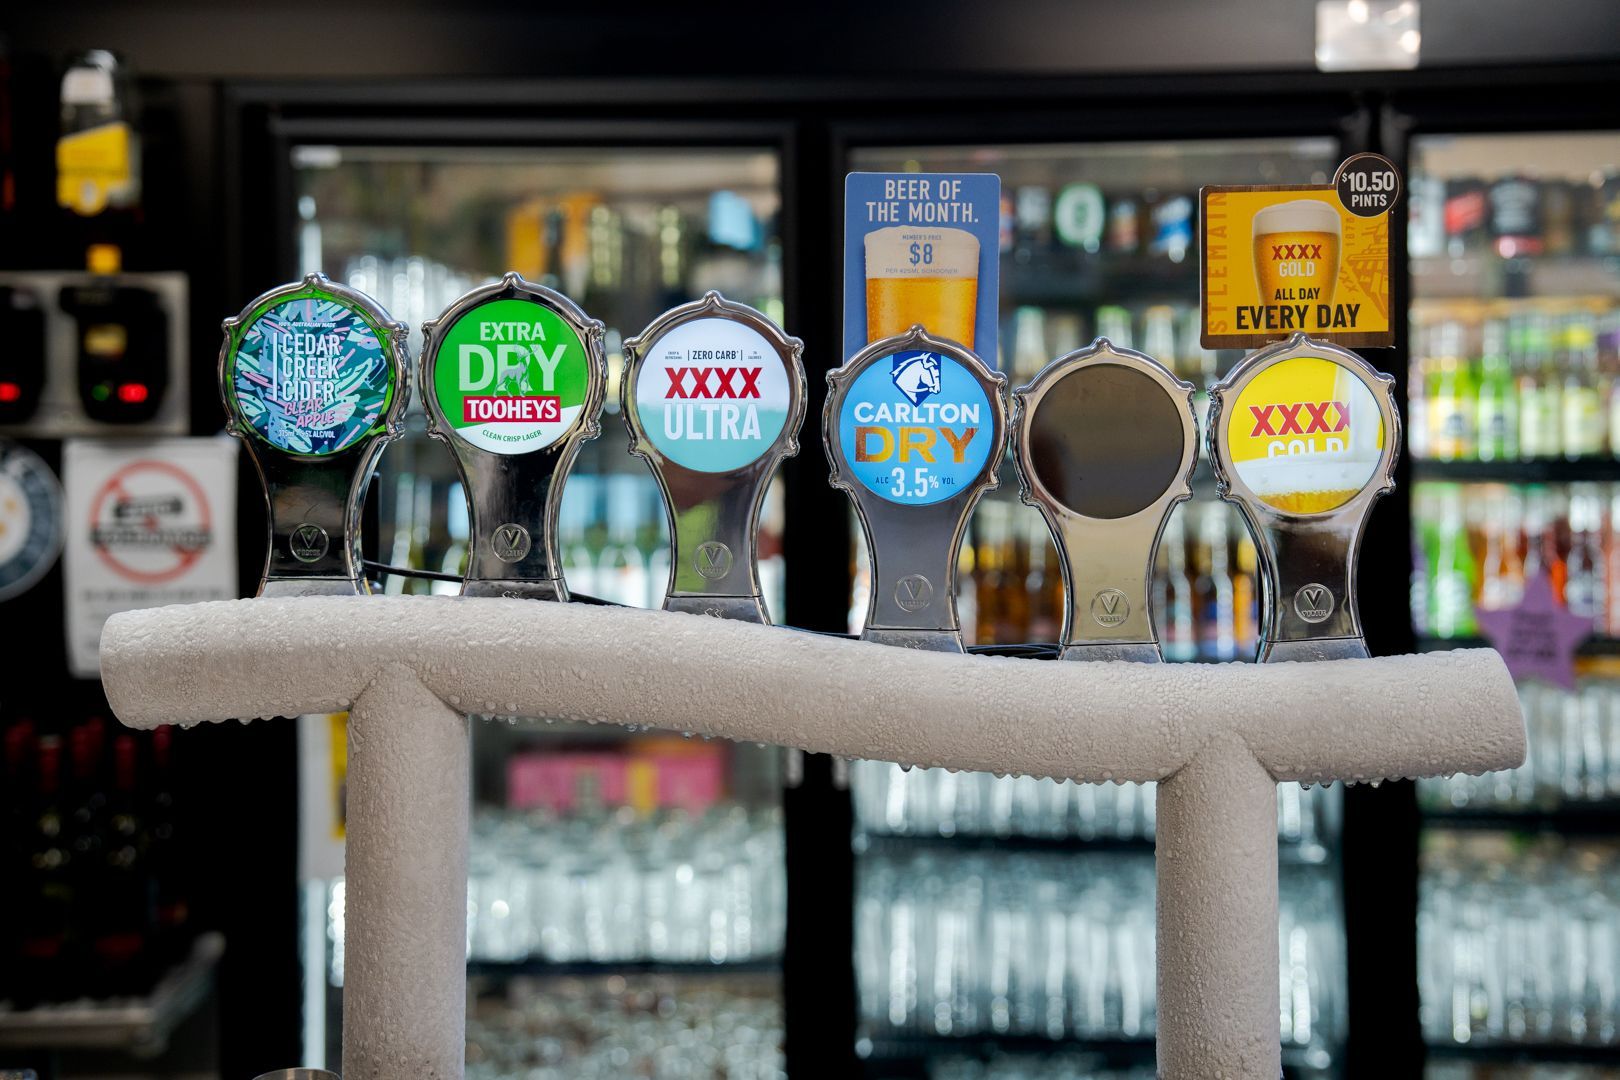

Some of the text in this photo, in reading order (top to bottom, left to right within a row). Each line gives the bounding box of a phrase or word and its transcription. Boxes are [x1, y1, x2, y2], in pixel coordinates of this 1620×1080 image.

[885, 180, 962, 200] BEER OF
[1342, 171, 1395, 192] $10.50
[1351, 194, 1387, 207] PINTS
[866, 202, 979, 223] THE MONTH.
[909, 241, 933, 266] $8
[1272, 244, 1322, 260] XXXX
[1279, 261, 1315, 277] GOLD
[1274, 287, 1321, 300] ALL DAY
[1236, 304, 1361, 330] EVERY DAY
[480, 322, 546, 341] EXTRA
[282, 333, 340, 355] CEDAR
[692, 350, 713, 360] ZERO
[282, 356, 340, 379] CREEK
[458, 344, 568, 392] DRY
[282, 380, 335, 403] CIDER
[664, 367, 763, 399] XXXX
[284, 398, 323, 416] CLEAR
[466, 398, 558, 420] TOOHEYS
[854, 402, 980, 424] CARLTON
[295, 410, 335, 429] APPLE
[664, 403, 761, 440] ULTRA
[482, 429, 502, 441] CLEAN
[522, 429, 542, 441] LAGER
[854, 426, 979, 464] DRY
[875, 467, 955, 498] ALC 3.5% VOL
